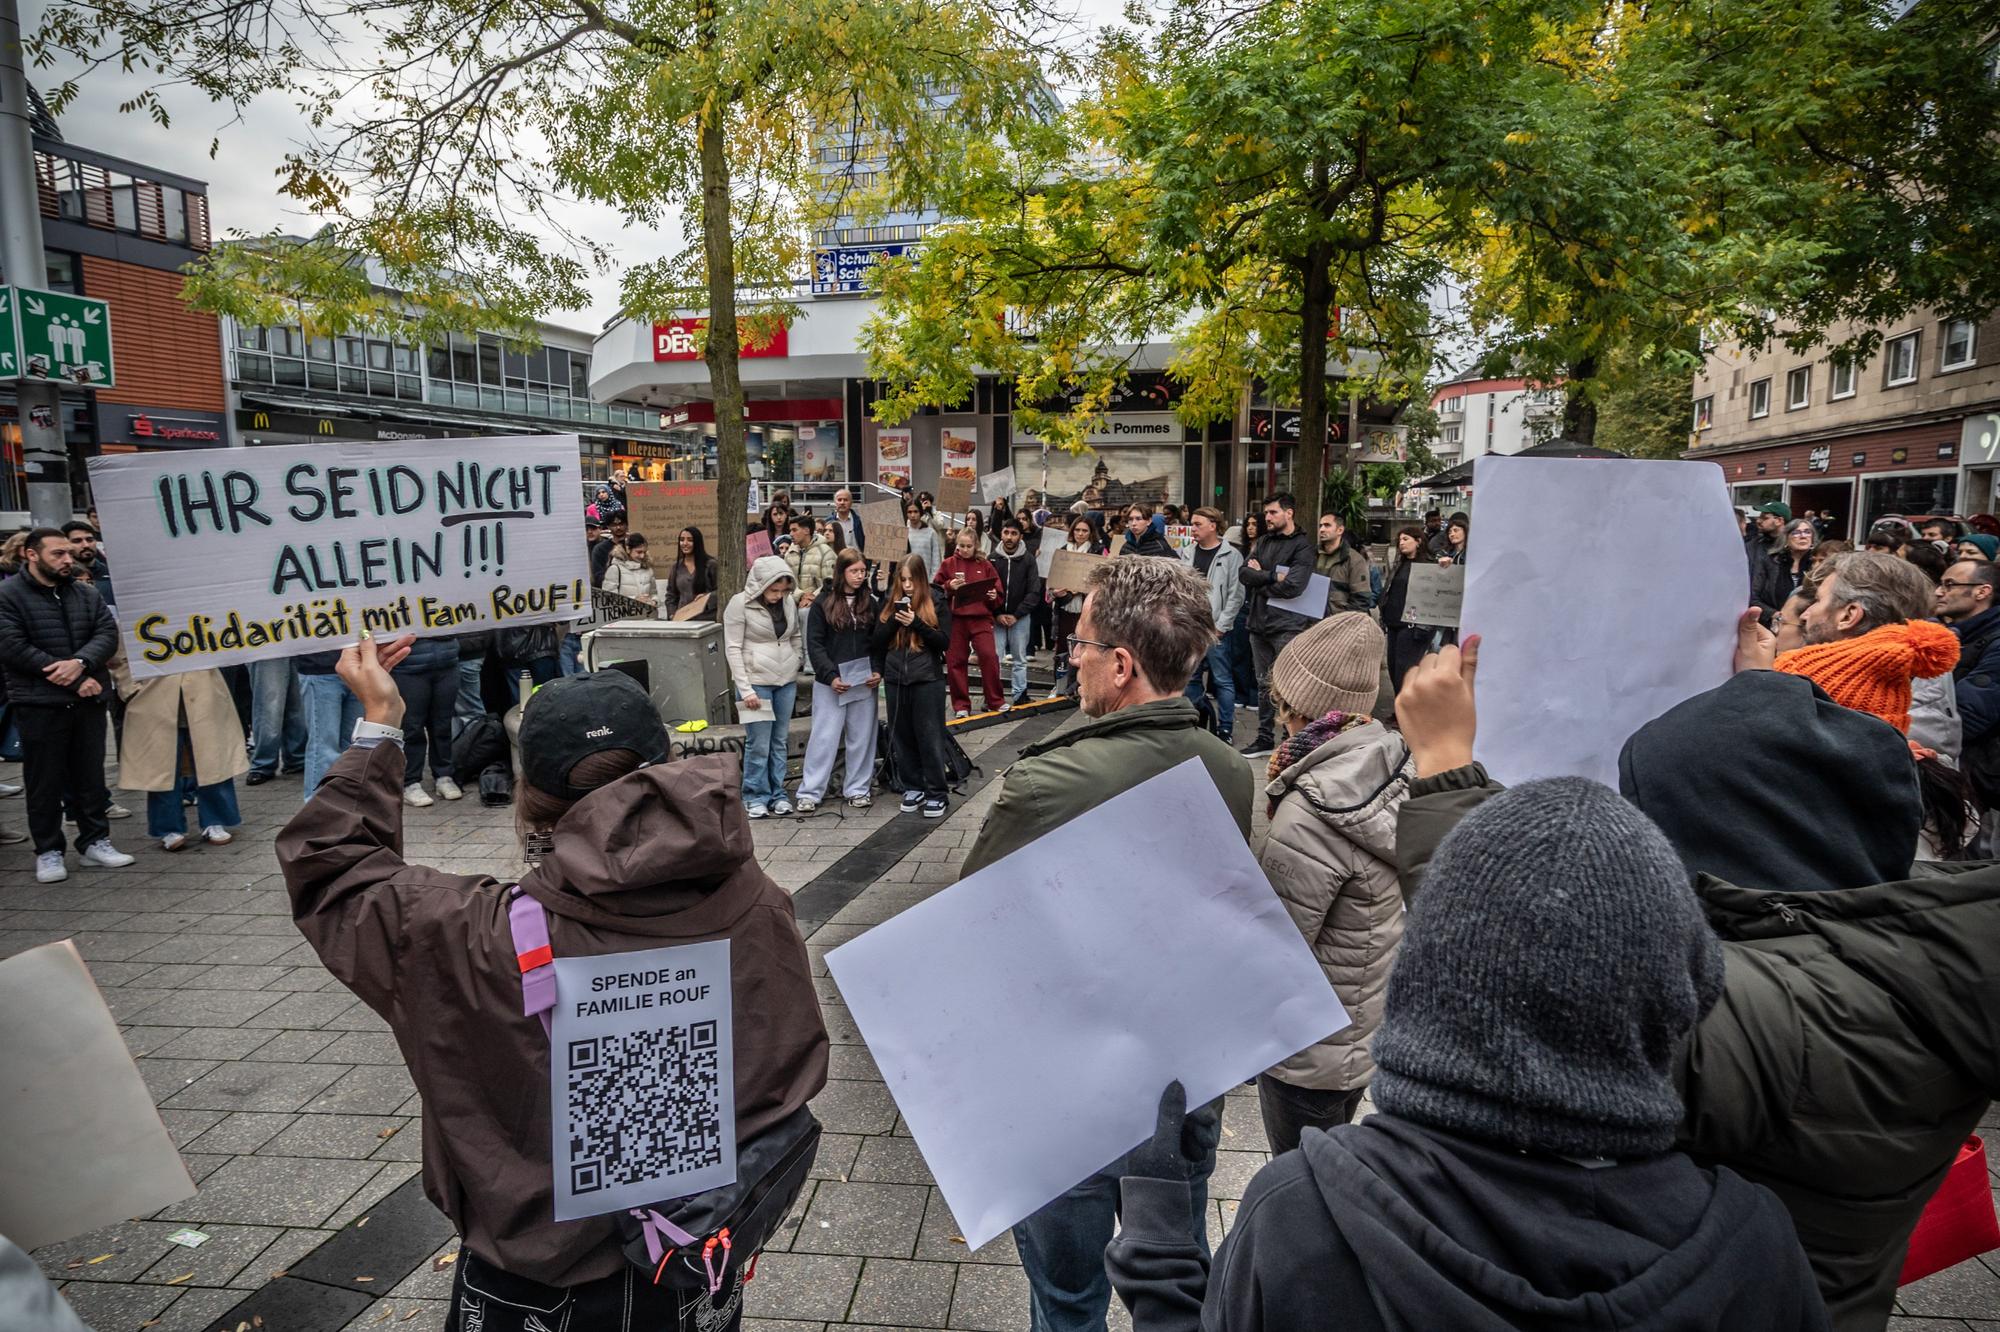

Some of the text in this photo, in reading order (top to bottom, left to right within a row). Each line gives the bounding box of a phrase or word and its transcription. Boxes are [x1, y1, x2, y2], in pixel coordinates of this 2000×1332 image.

[158, 425, 220, 441] Sparkasse
[1114, 423, 1170, 435] Pommes
[1370, 430, 1400, 455] TEA
[159, 461, 561, 537] IHR SEID NICHT
[1167, 526, 1191, 537] FAMI
[272, 532, 443, 594] ALLEIN
[599, 606, 643, 623] TRENNEN
[139, 598, 350, 662] Solidarität
[362, 596, 411, 631] mit
[420, 596, 486, 628] Fam.
[585, 725, 614, 739] renk.
[1264, 856, 1296, 879] CECIL
[591, 968, 696, 992] SPENDE an
[577, 985, 711, 1017] FAMILIE ROUF
